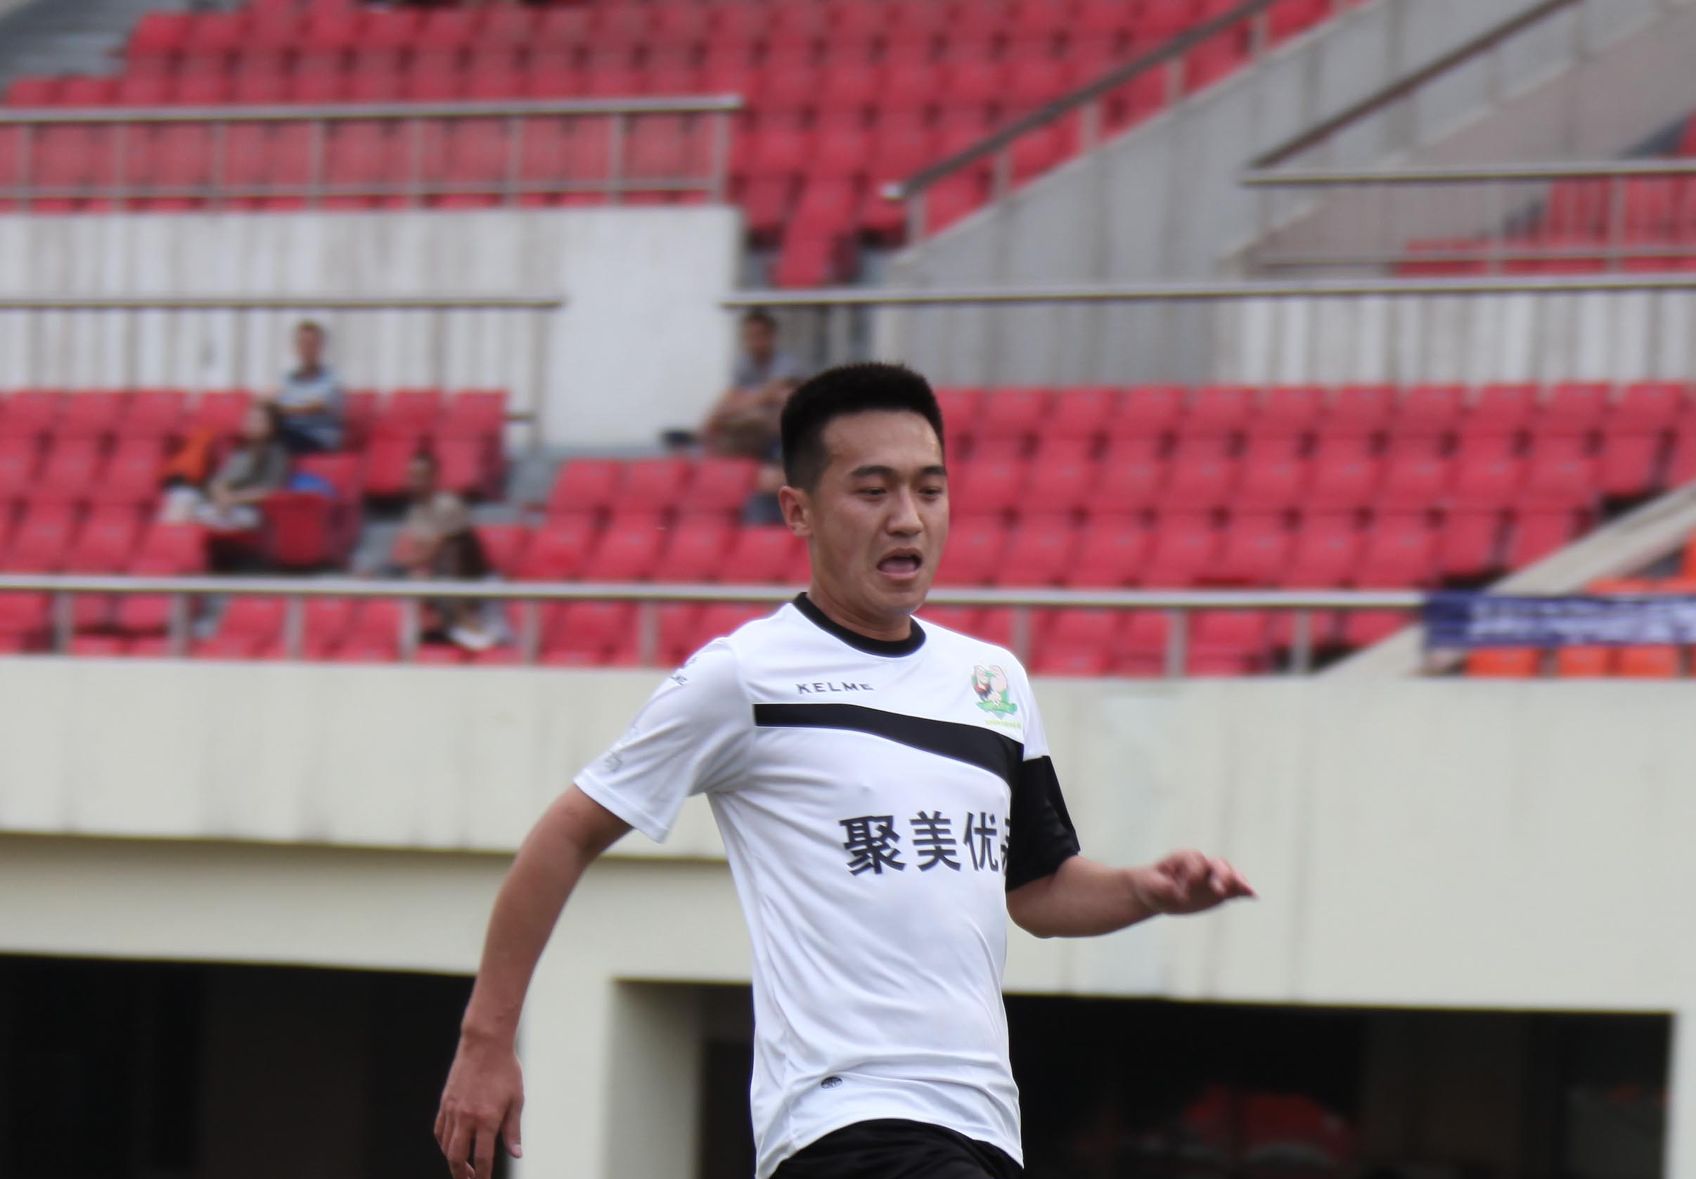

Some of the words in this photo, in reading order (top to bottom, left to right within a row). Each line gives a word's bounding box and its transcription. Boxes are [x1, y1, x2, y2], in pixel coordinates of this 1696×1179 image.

[796, 682, 874, 694] KELME
[839, 811, 1010, 875] 聚美优
